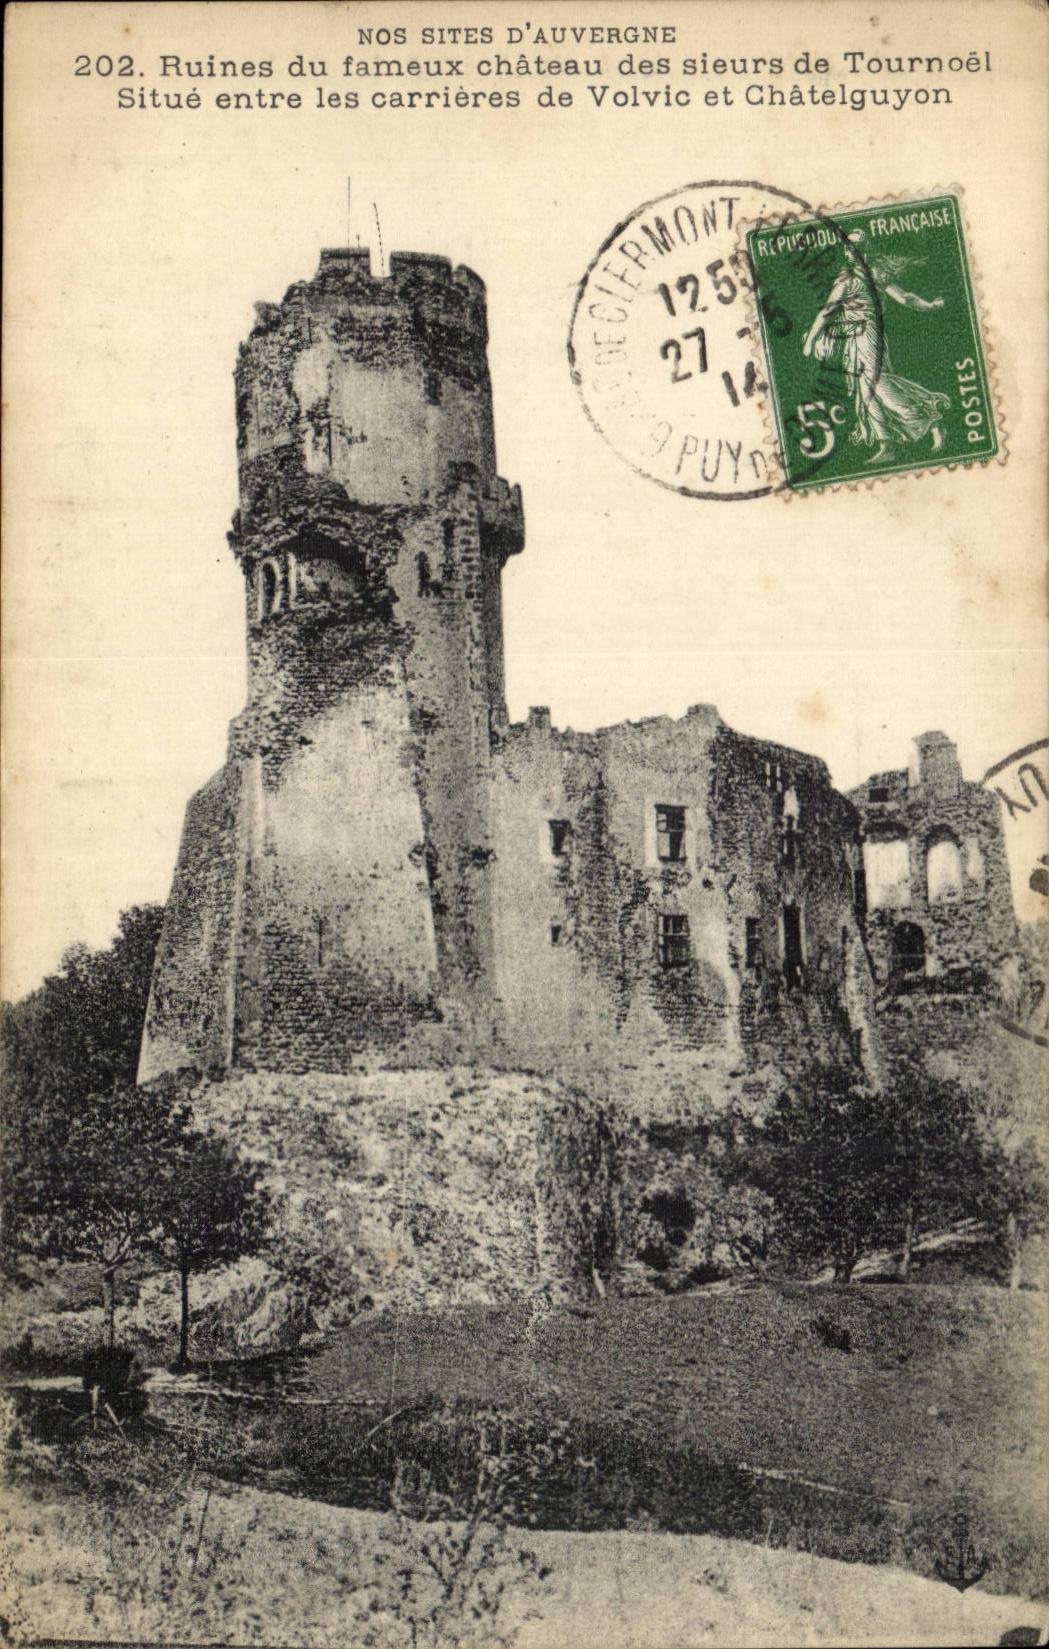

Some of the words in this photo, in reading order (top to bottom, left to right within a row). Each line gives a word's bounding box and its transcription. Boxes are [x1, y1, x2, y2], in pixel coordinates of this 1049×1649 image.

[869, 207, 951, 237] FRANÇAISE
[660, 327, 708, 384] 27
[955, 356, 986, 443] POSTES
[675, 433, 743, 484] PUY
